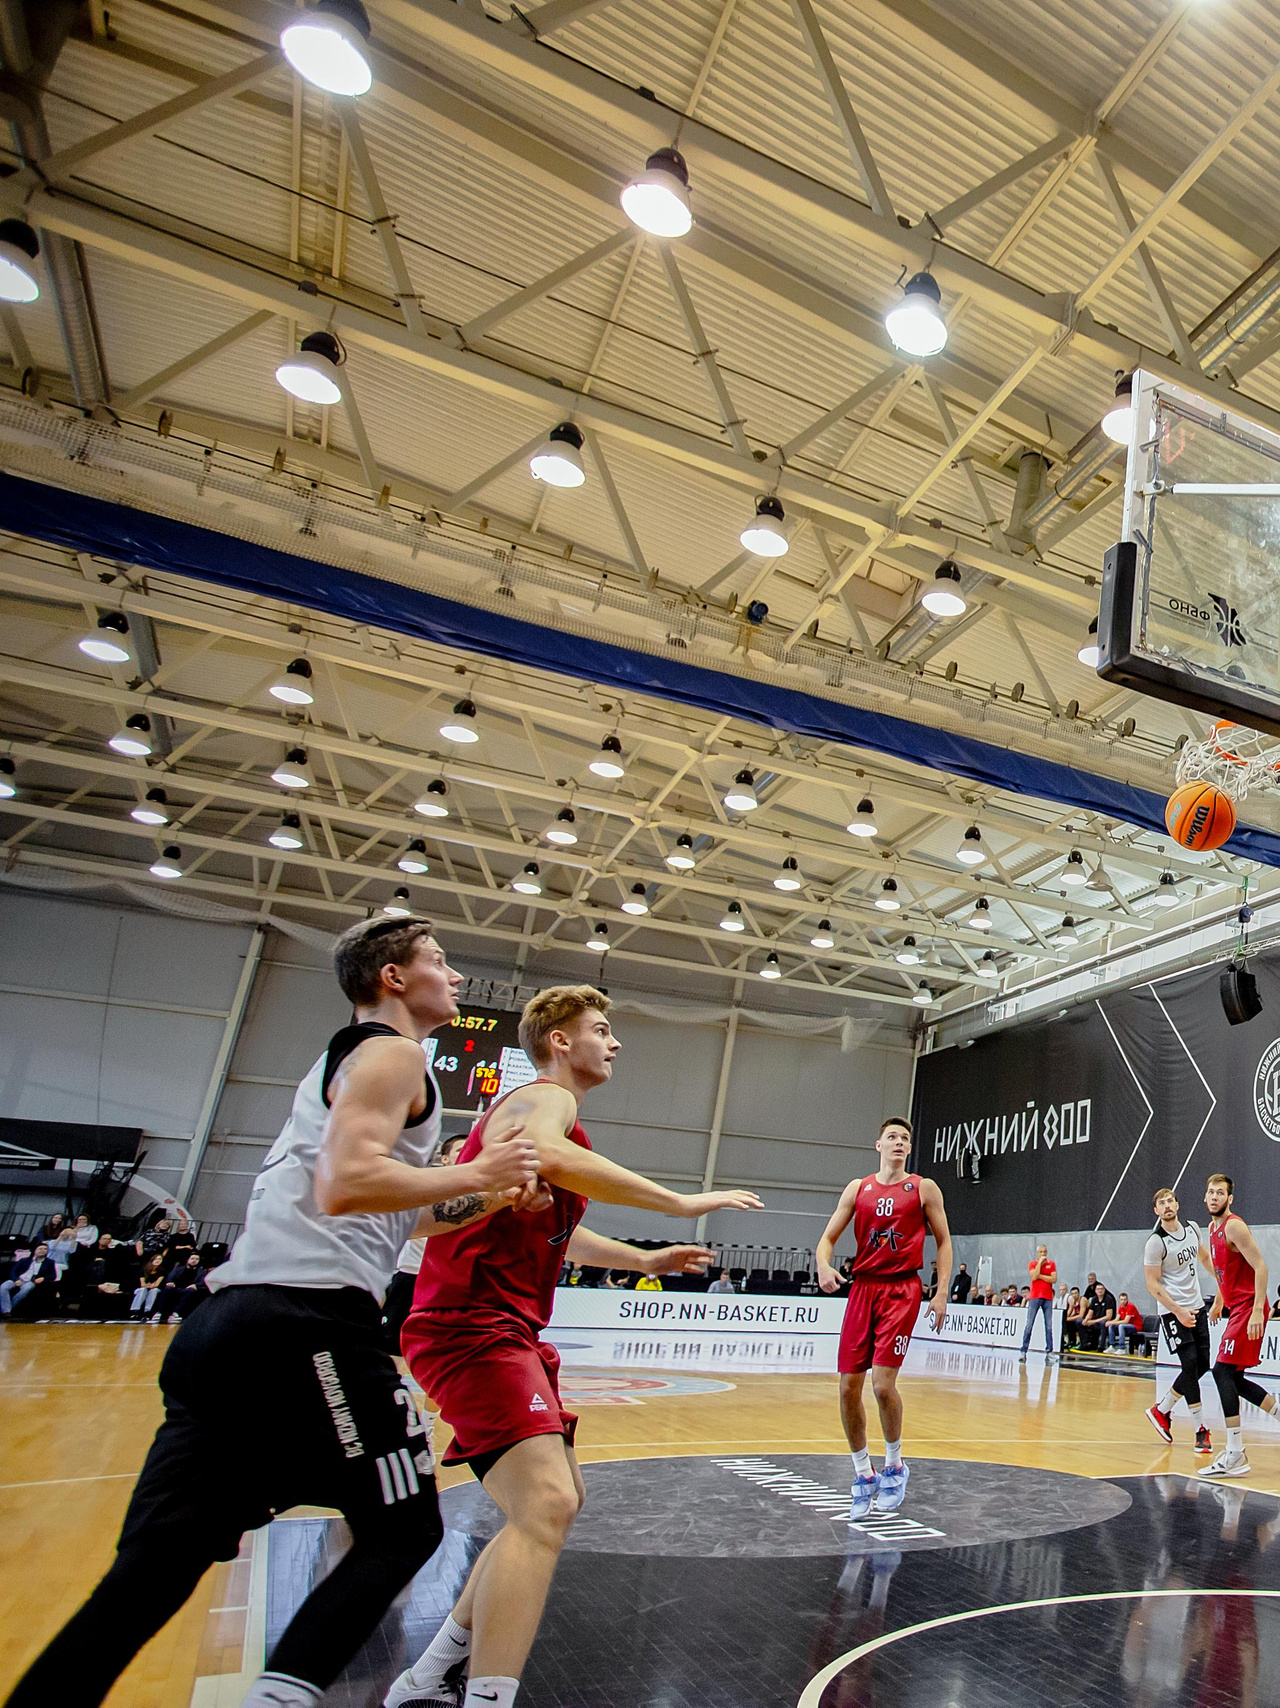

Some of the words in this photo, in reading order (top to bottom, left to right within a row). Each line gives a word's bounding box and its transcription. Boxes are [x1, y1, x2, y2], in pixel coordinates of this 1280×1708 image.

[1184, 805, 1210, 847] Wilson
[464, 1039, 476, 1052] 2
[433, 1055, 459, 1072] 43
[480, 1078, 500, 1094] 10
[934, 1101, 1038, 1164] НИЖНИЙ
[1043, 1099, 1092, 1150] 800
[876, 1197, 894, 1217] 38
[1189, 1263, 1195, 1277] 5
[619, 1300, 820, 1325] SHOP.NN-BASKET.RU
[929, 1312, 1018, 1337] SP.NN-BASKET.RU
[1169, 1320, 1178, 1335] 5
[893, 1334, 909, 1356] 38
[1224, 1338, 1235, 1356] 14
[312, 1351, 347, 1408] NOVGOROD
[331, 1406, 360, 1444] NIZHNY
[344, 1442, 365, 1459] BC
